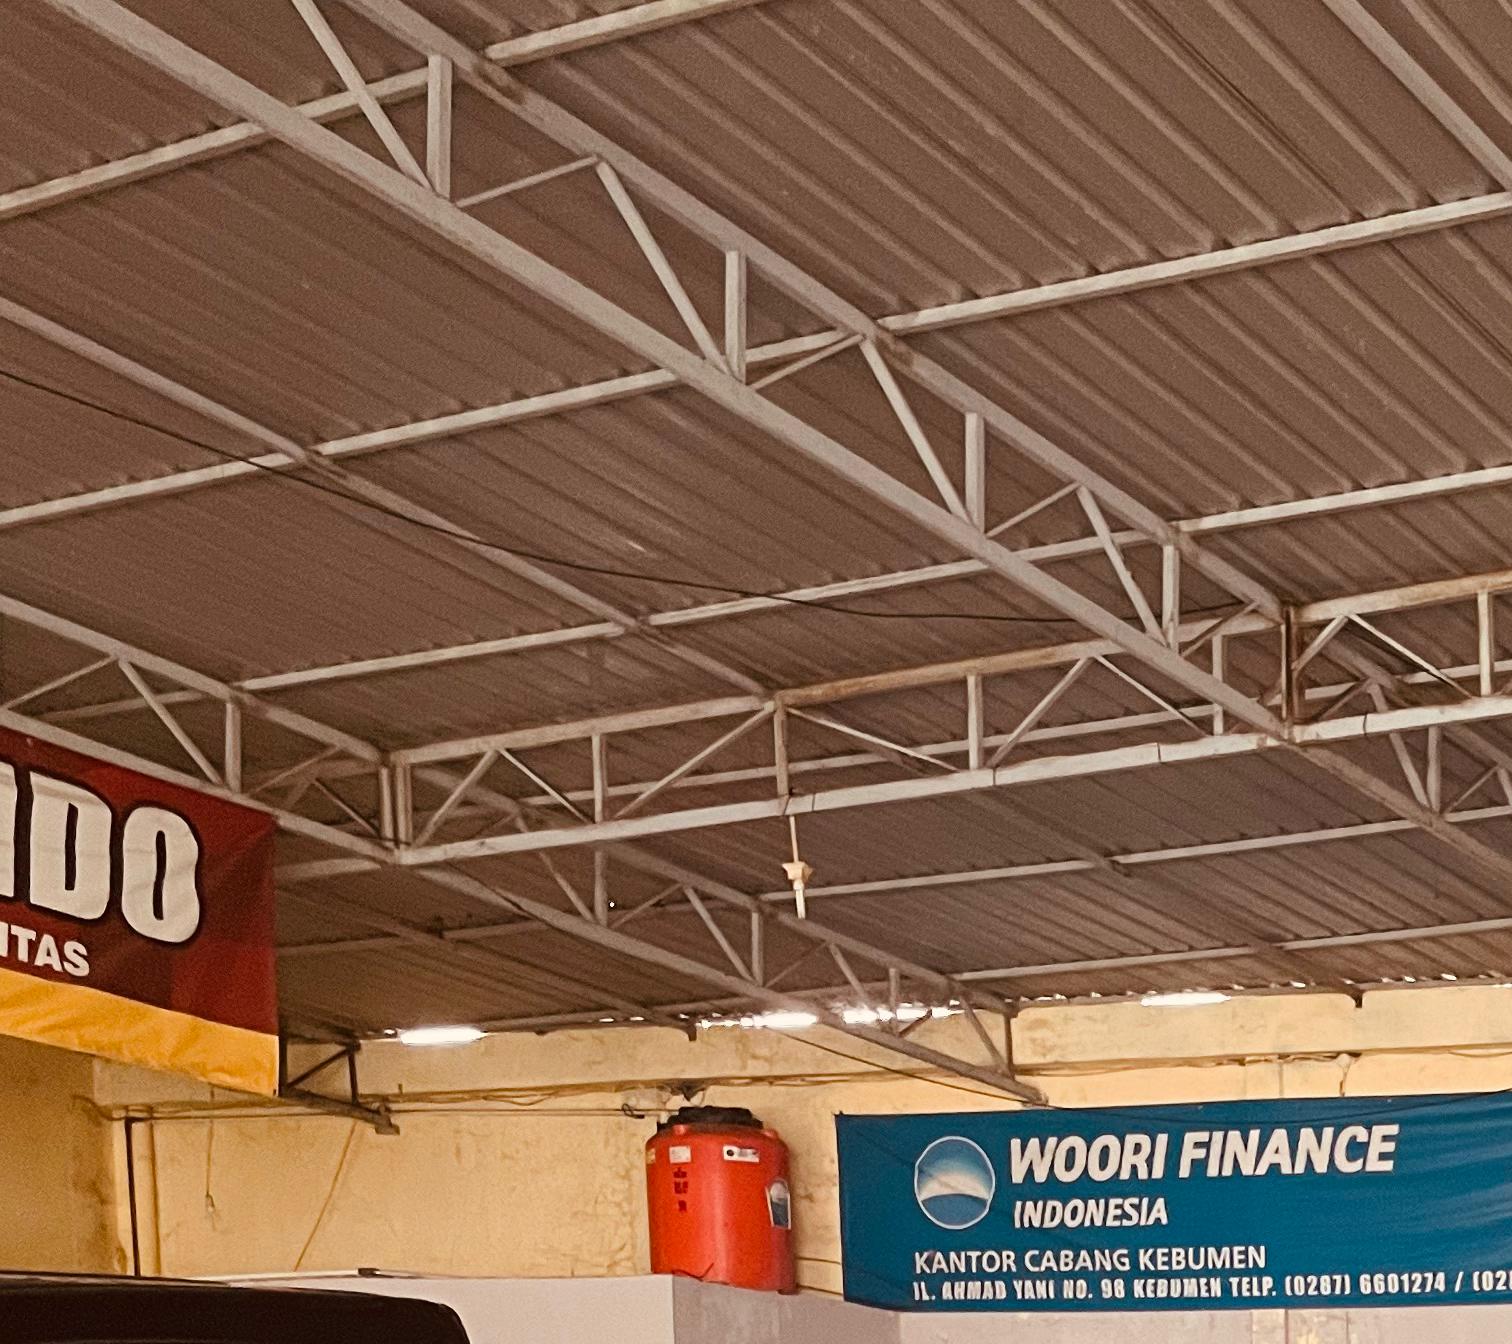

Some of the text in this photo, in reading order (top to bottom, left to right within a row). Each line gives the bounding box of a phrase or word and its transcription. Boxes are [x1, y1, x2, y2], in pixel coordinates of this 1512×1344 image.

[0, 760, 200, 943] DO
[1010, 1124, 1399, 1183] WOORI FINANCE
[1013, 1197, 1168, 1228] INDONESIA
[914, 1246, 1266, 1274] KANTOR CABANG KEBUMEN
[942, 1281, 1007, 1300] AHMAD
[1013, 1280, 1055, 1299] YANI
[1063, 1279, 1093, 1299] NO.
[1133, 1277, 1222, 1298] KEBUMEN
[1229, 1275, 1277, 1297] TELP.
[1285, 1274, 1351, 1296] (0287)
[1359, 1271, 1446, 1294] 6601274
[1454, 1271, 1464, 1293] /
